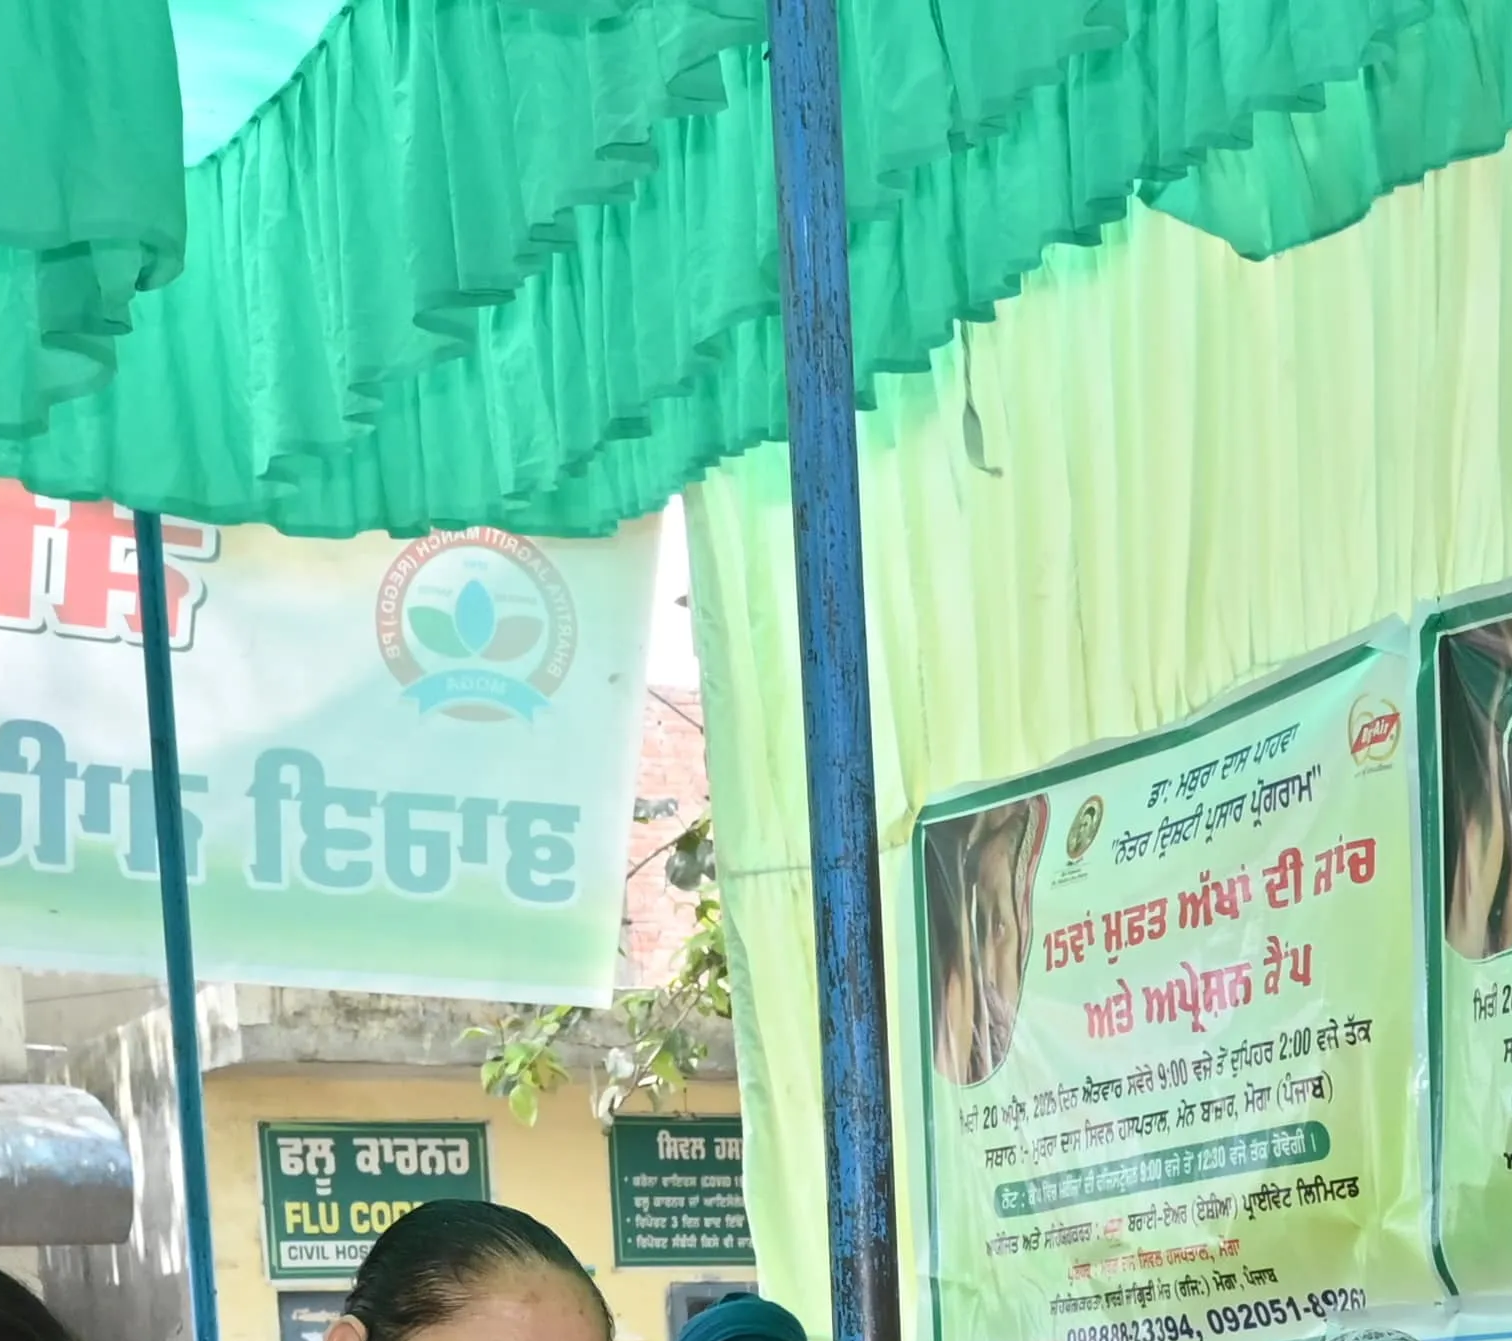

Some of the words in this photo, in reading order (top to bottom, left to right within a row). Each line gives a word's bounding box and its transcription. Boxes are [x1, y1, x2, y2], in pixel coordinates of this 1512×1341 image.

[1262, 847, 1304, 909] ਦੀ
[983, 1105, 998, 1130] 20
[1158, 1058, 1188, 1090] 9:00
[1279, 1027, 1311, 1060] 2:00
[353, 1137, 470, 1176] ਕਾਰਨਰ
[657, 1130, 706, 1160] ਸਿਵਲ
[285, 1201, 340, 1235] FLU
[350, 1200, 425, 1234] COR
[288, 1245, 330, 1261] CIVIL
[336, 1244, 375, 1260] HOS
